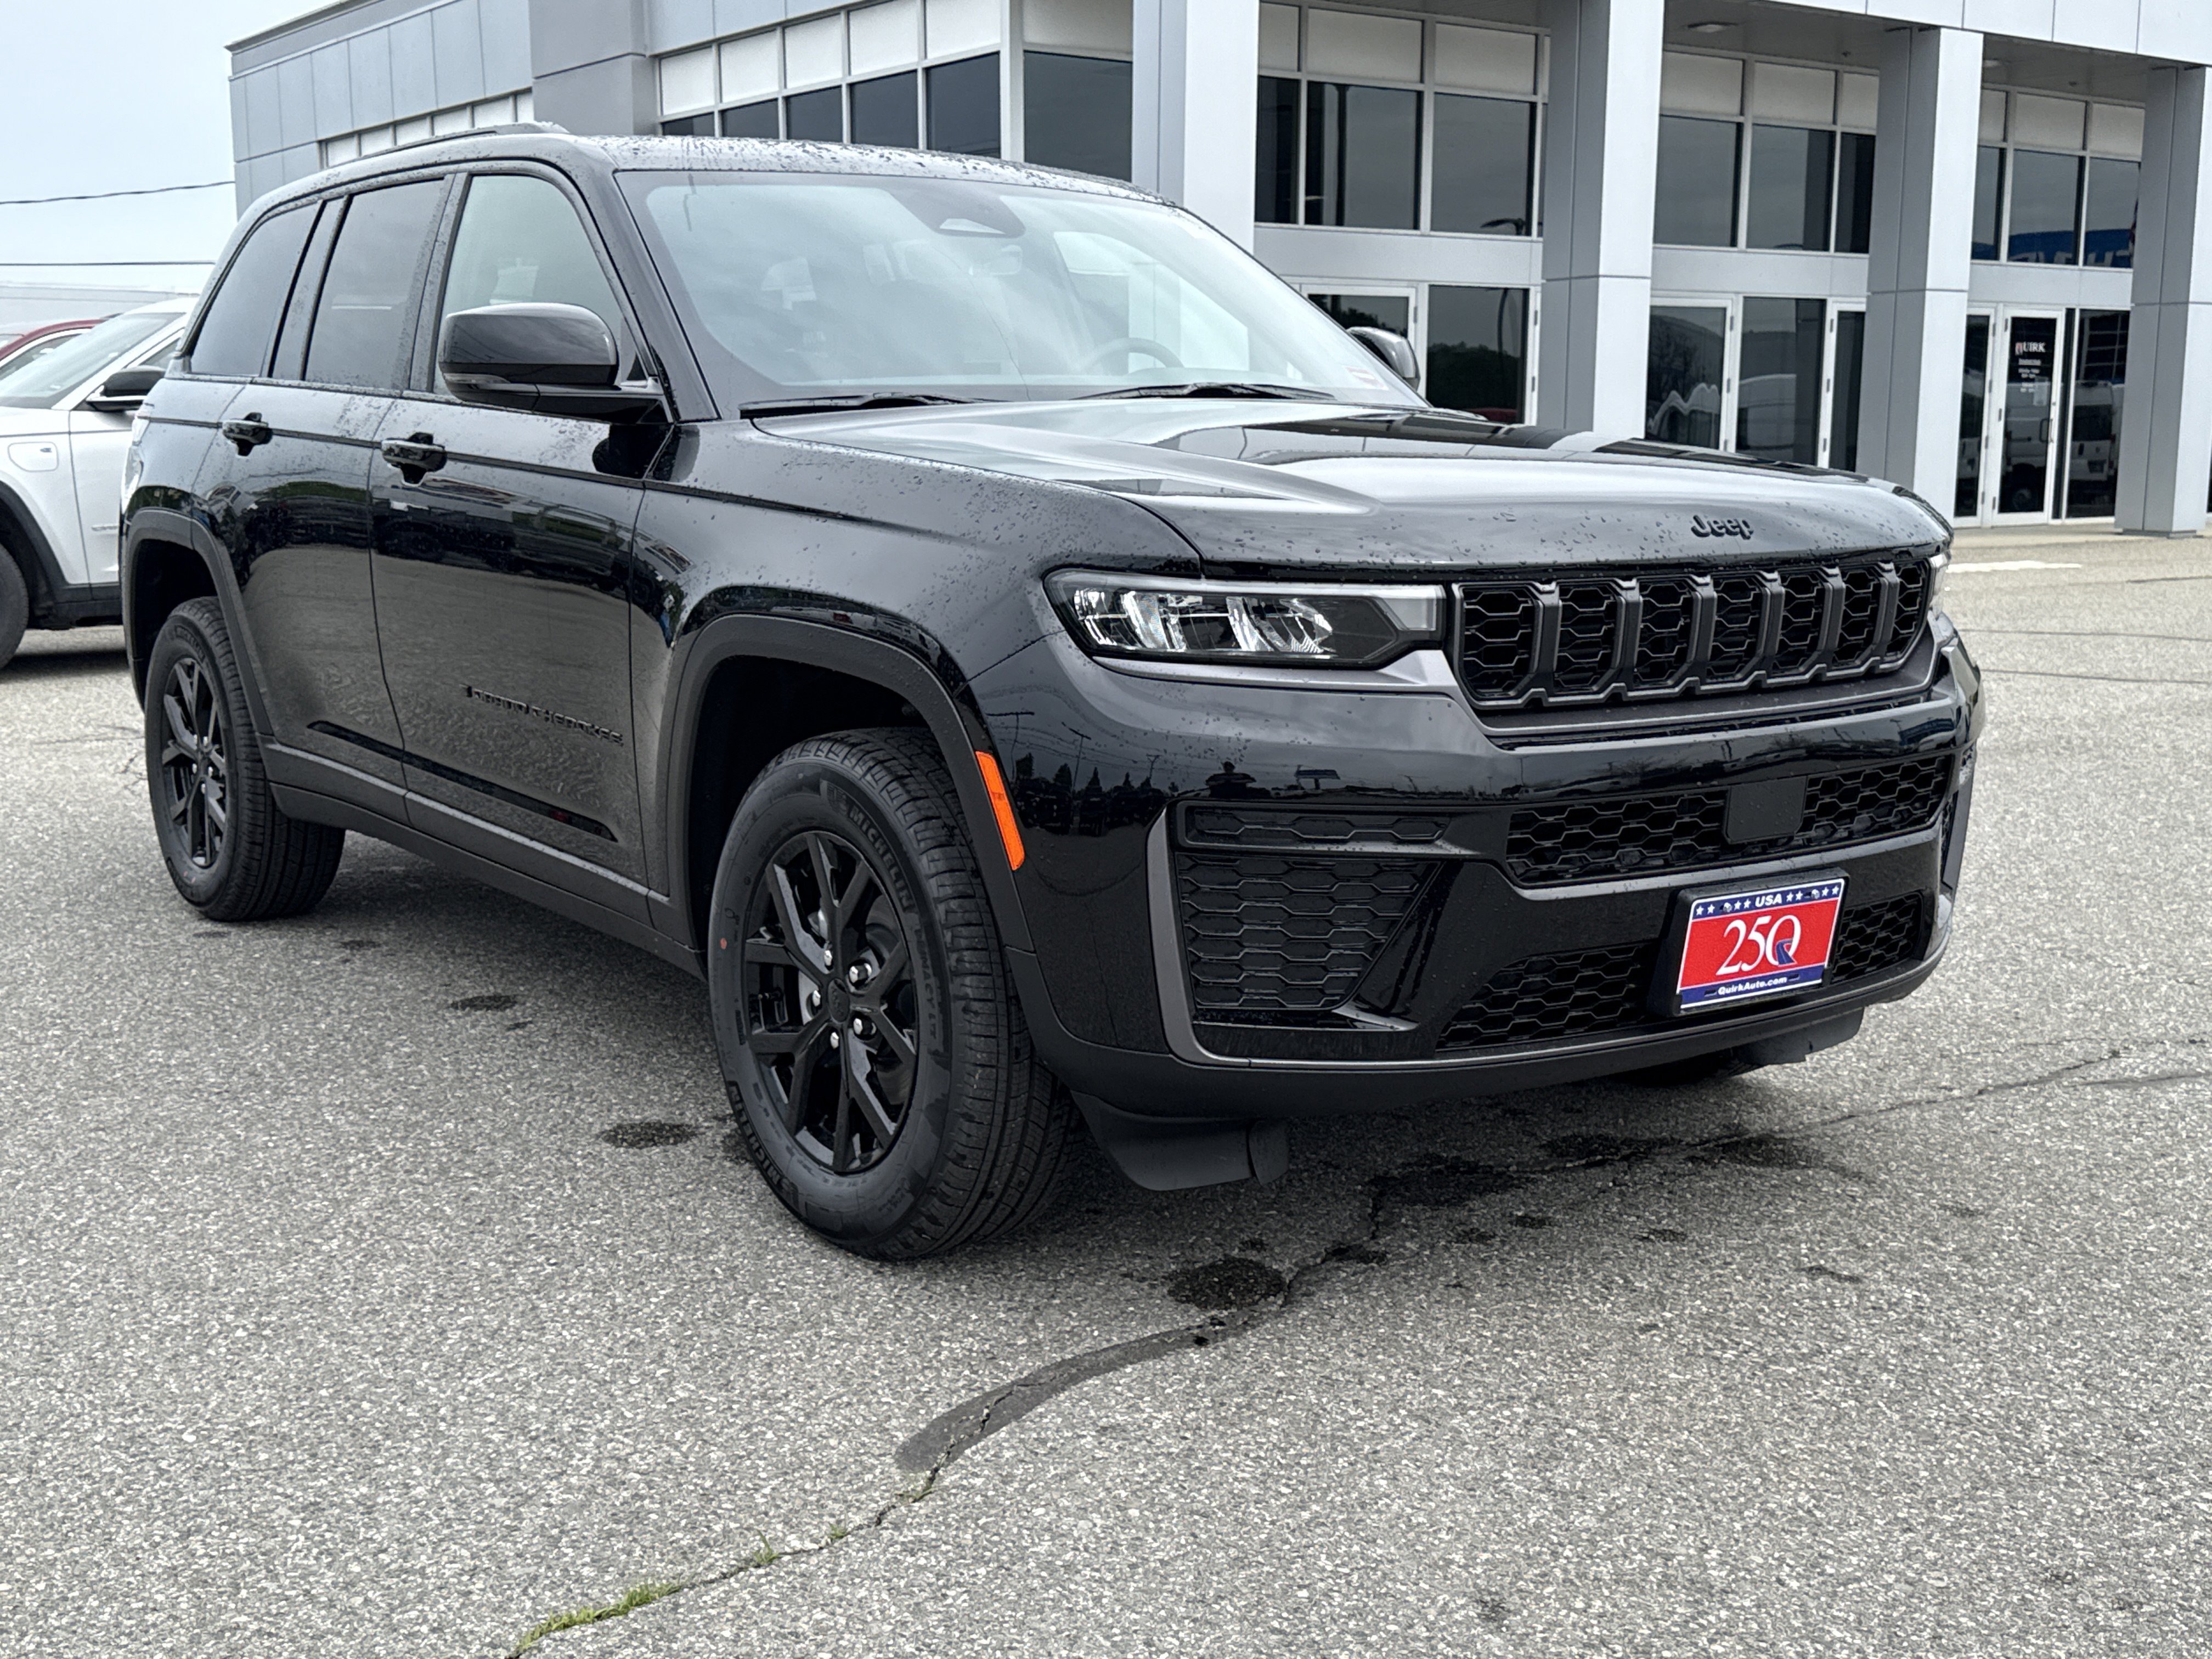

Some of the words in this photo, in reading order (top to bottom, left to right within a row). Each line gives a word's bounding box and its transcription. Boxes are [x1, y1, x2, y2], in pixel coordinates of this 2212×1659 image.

[1691, 515, 1754, 540] Jeep
[849, 805, 917, 913] MICHELIN
[1756, 893, 1783, 908] USA
[1718, 976, 1787, 996] QuirkAuto.com
